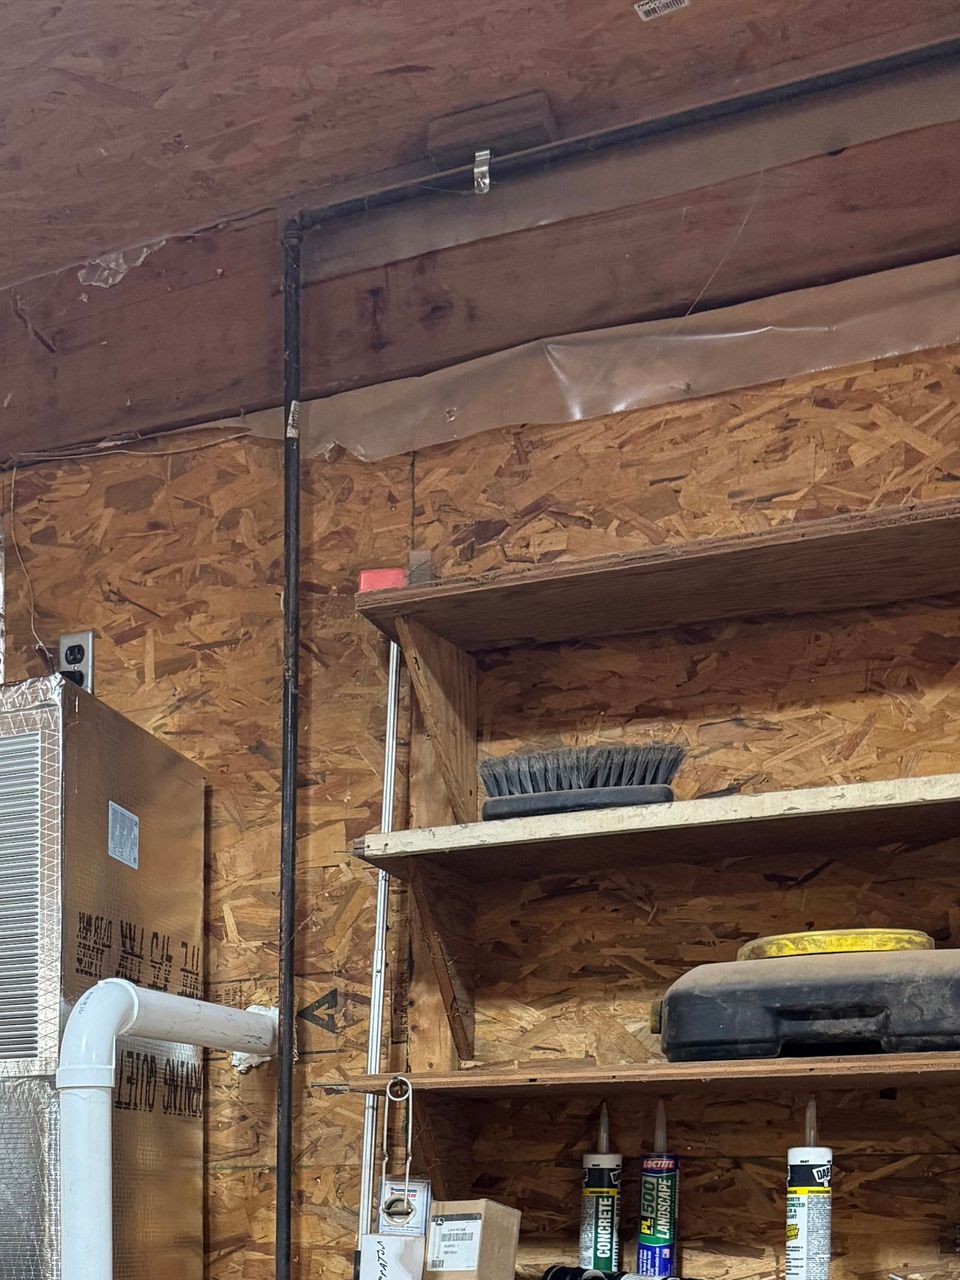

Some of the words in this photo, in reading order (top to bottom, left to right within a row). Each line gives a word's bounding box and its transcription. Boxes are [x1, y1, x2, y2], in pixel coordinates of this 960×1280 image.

[642, 1159, 675, 1170] LOCTITE
[643, 1180, 655, 1214] 500
[657, 1179, 672, 1239] LANDSCAPE
[597, 1197, 611, 1258] CONCRETE
[641, 1218, 651, 1234] PL
